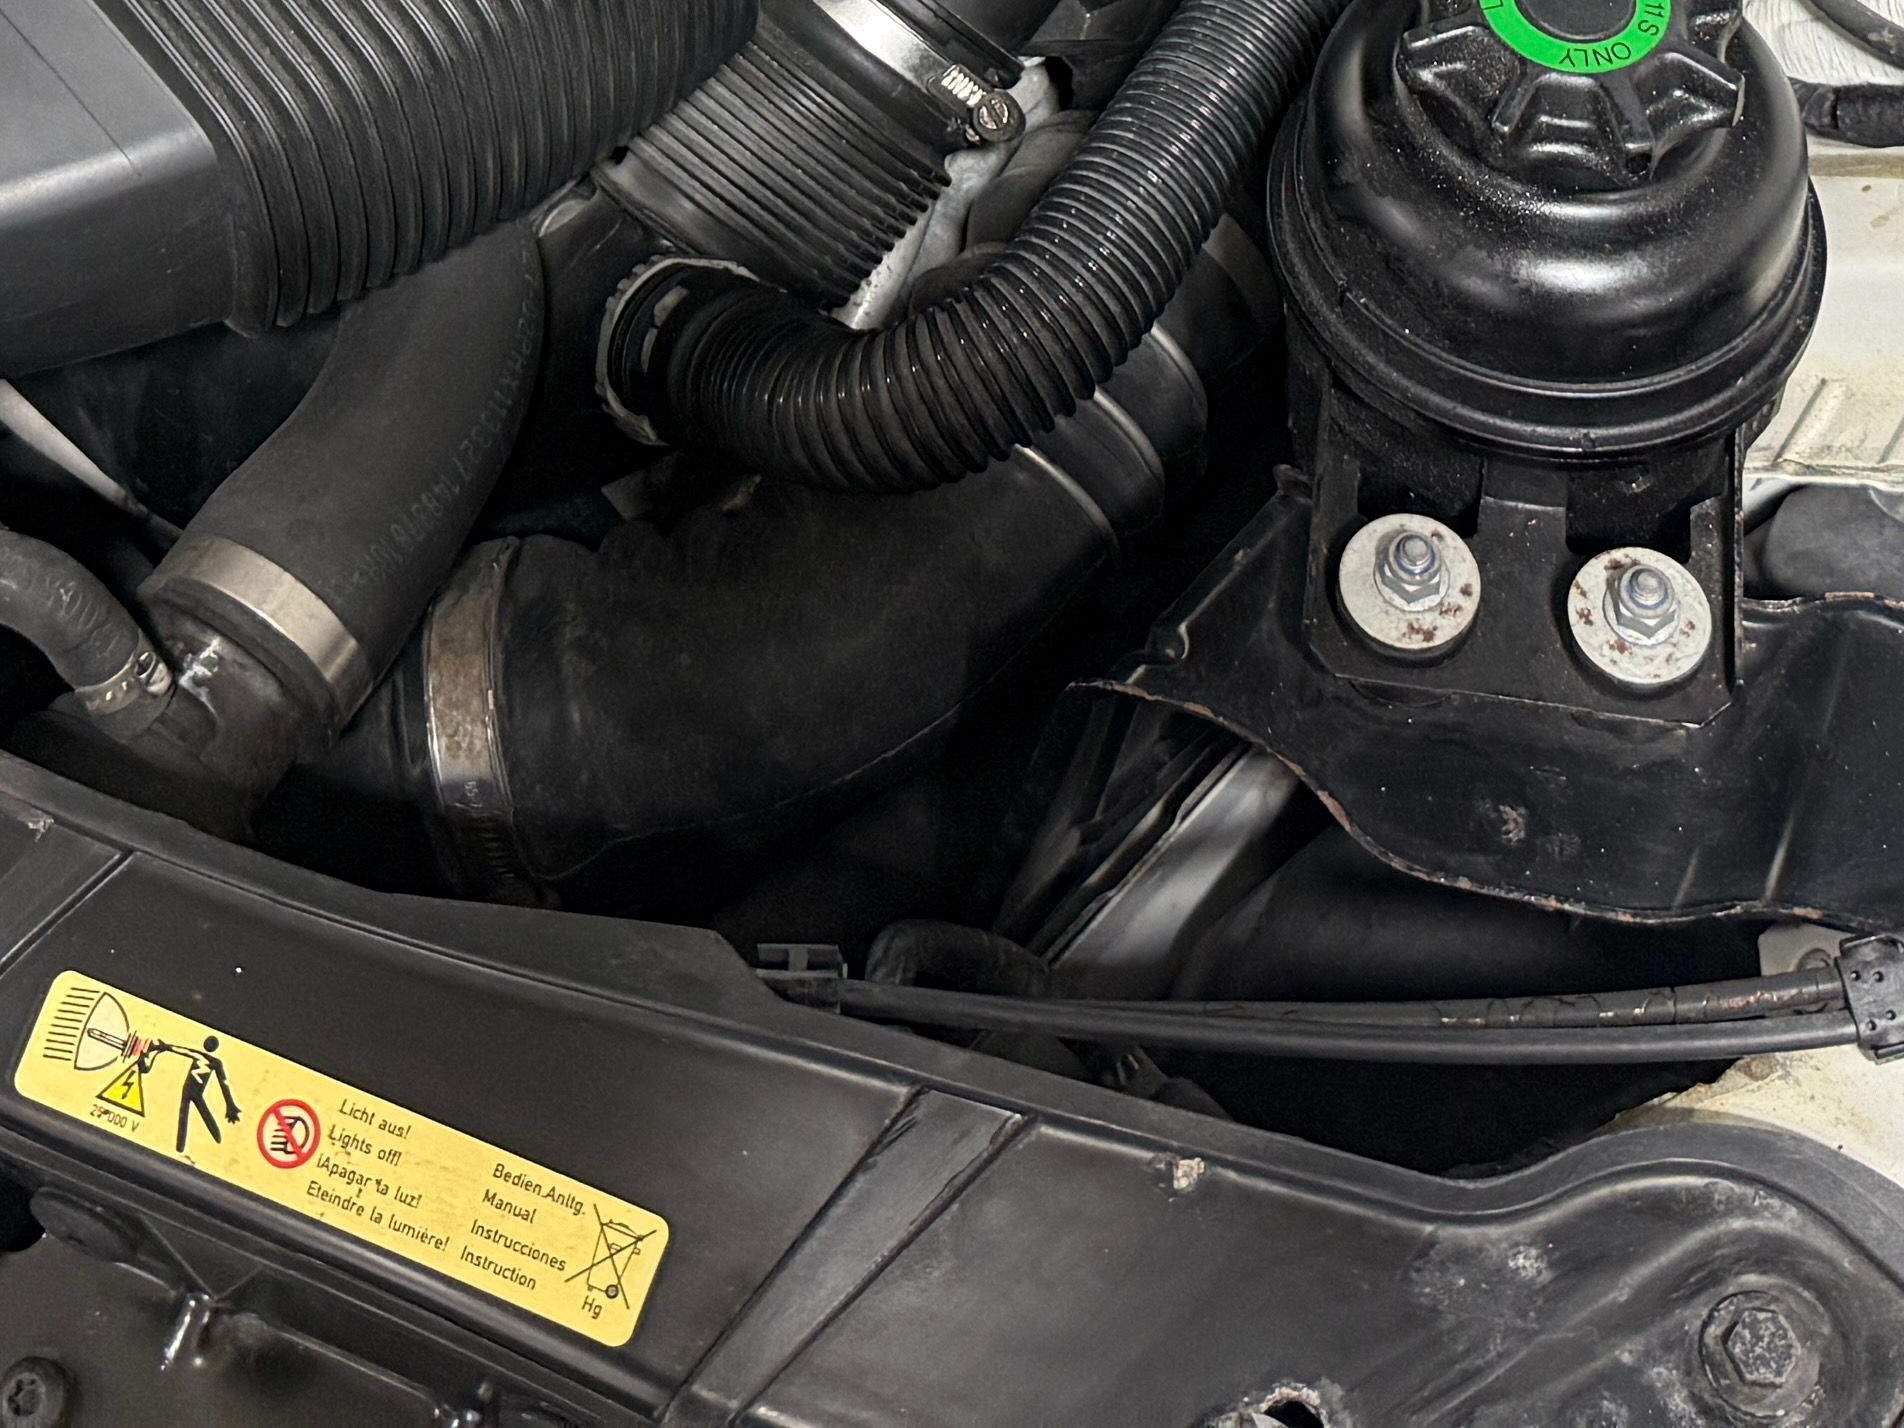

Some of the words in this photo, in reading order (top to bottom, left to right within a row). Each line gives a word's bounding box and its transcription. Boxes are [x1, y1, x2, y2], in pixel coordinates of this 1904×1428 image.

[1637, 2, 1665, 36] 11S
[1559, 41, 1632, 68] ONLY
[130, 1120, 140, 1132] V
[338, 1098, 375, 1126] Licht
[377, 1118, 411, 1139] aus!
[327, 1123, 372, 1155] Lights
[376, 1147, 402, 1167] off!
[374, 1177, 390, 1196] la
[393, 1184, 423, 1209] luz!
[481, 1188, 537, 1224] Manual
[368, 1205, 383, 1224] la
[387, 1213, 450, 1251] lumière!
[470, 1218, 566, 1271] Instrucciones
[459, 1244, 536, 1290] Instruction
[580, 1294, 603, 1320] Hg
